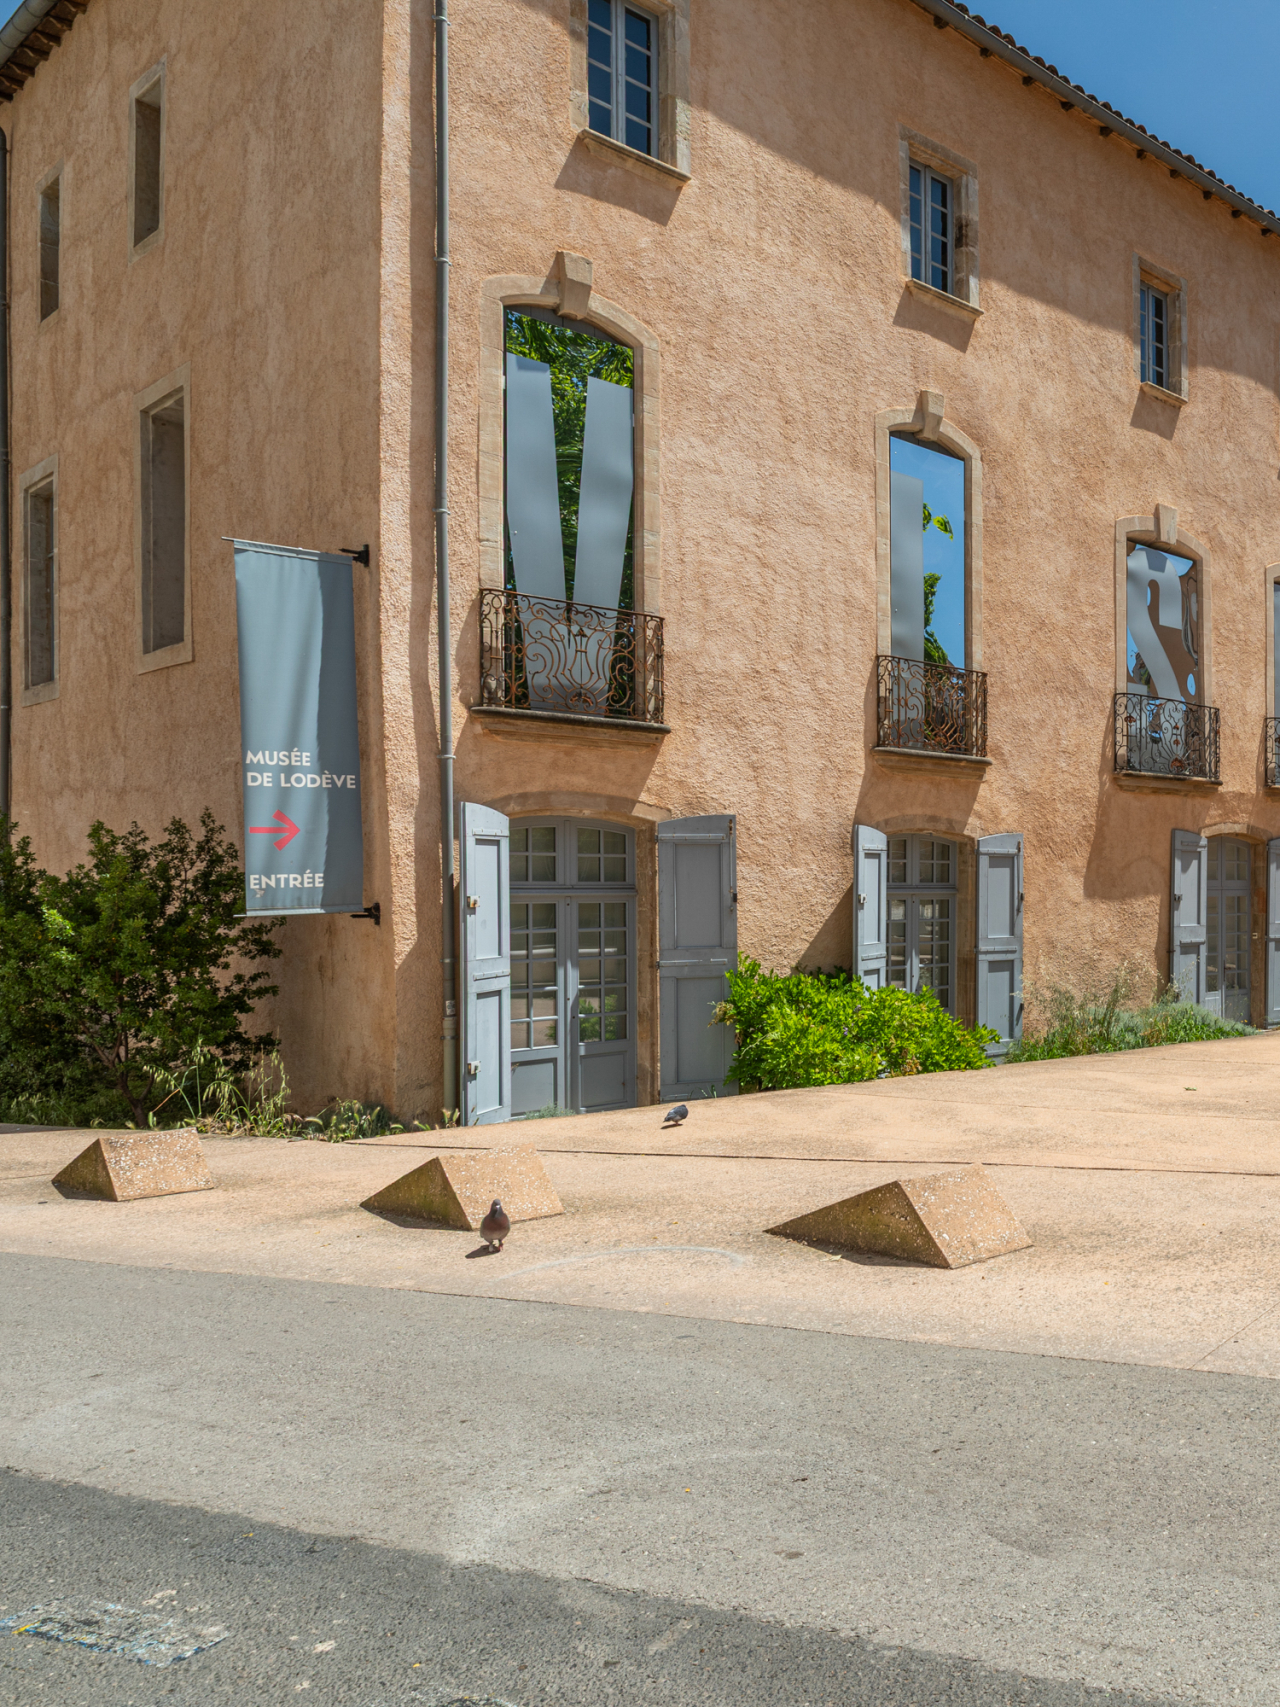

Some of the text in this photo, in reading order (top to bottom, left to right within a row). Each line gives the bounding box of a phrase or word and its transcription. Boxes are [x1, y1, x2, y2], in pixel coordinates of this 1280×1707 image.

[245, 747, 311, 767] MUSÉE
[246, 770, 356, 789] DE LODÈVE
[249, 869, 325, 889] ENTRÉE
